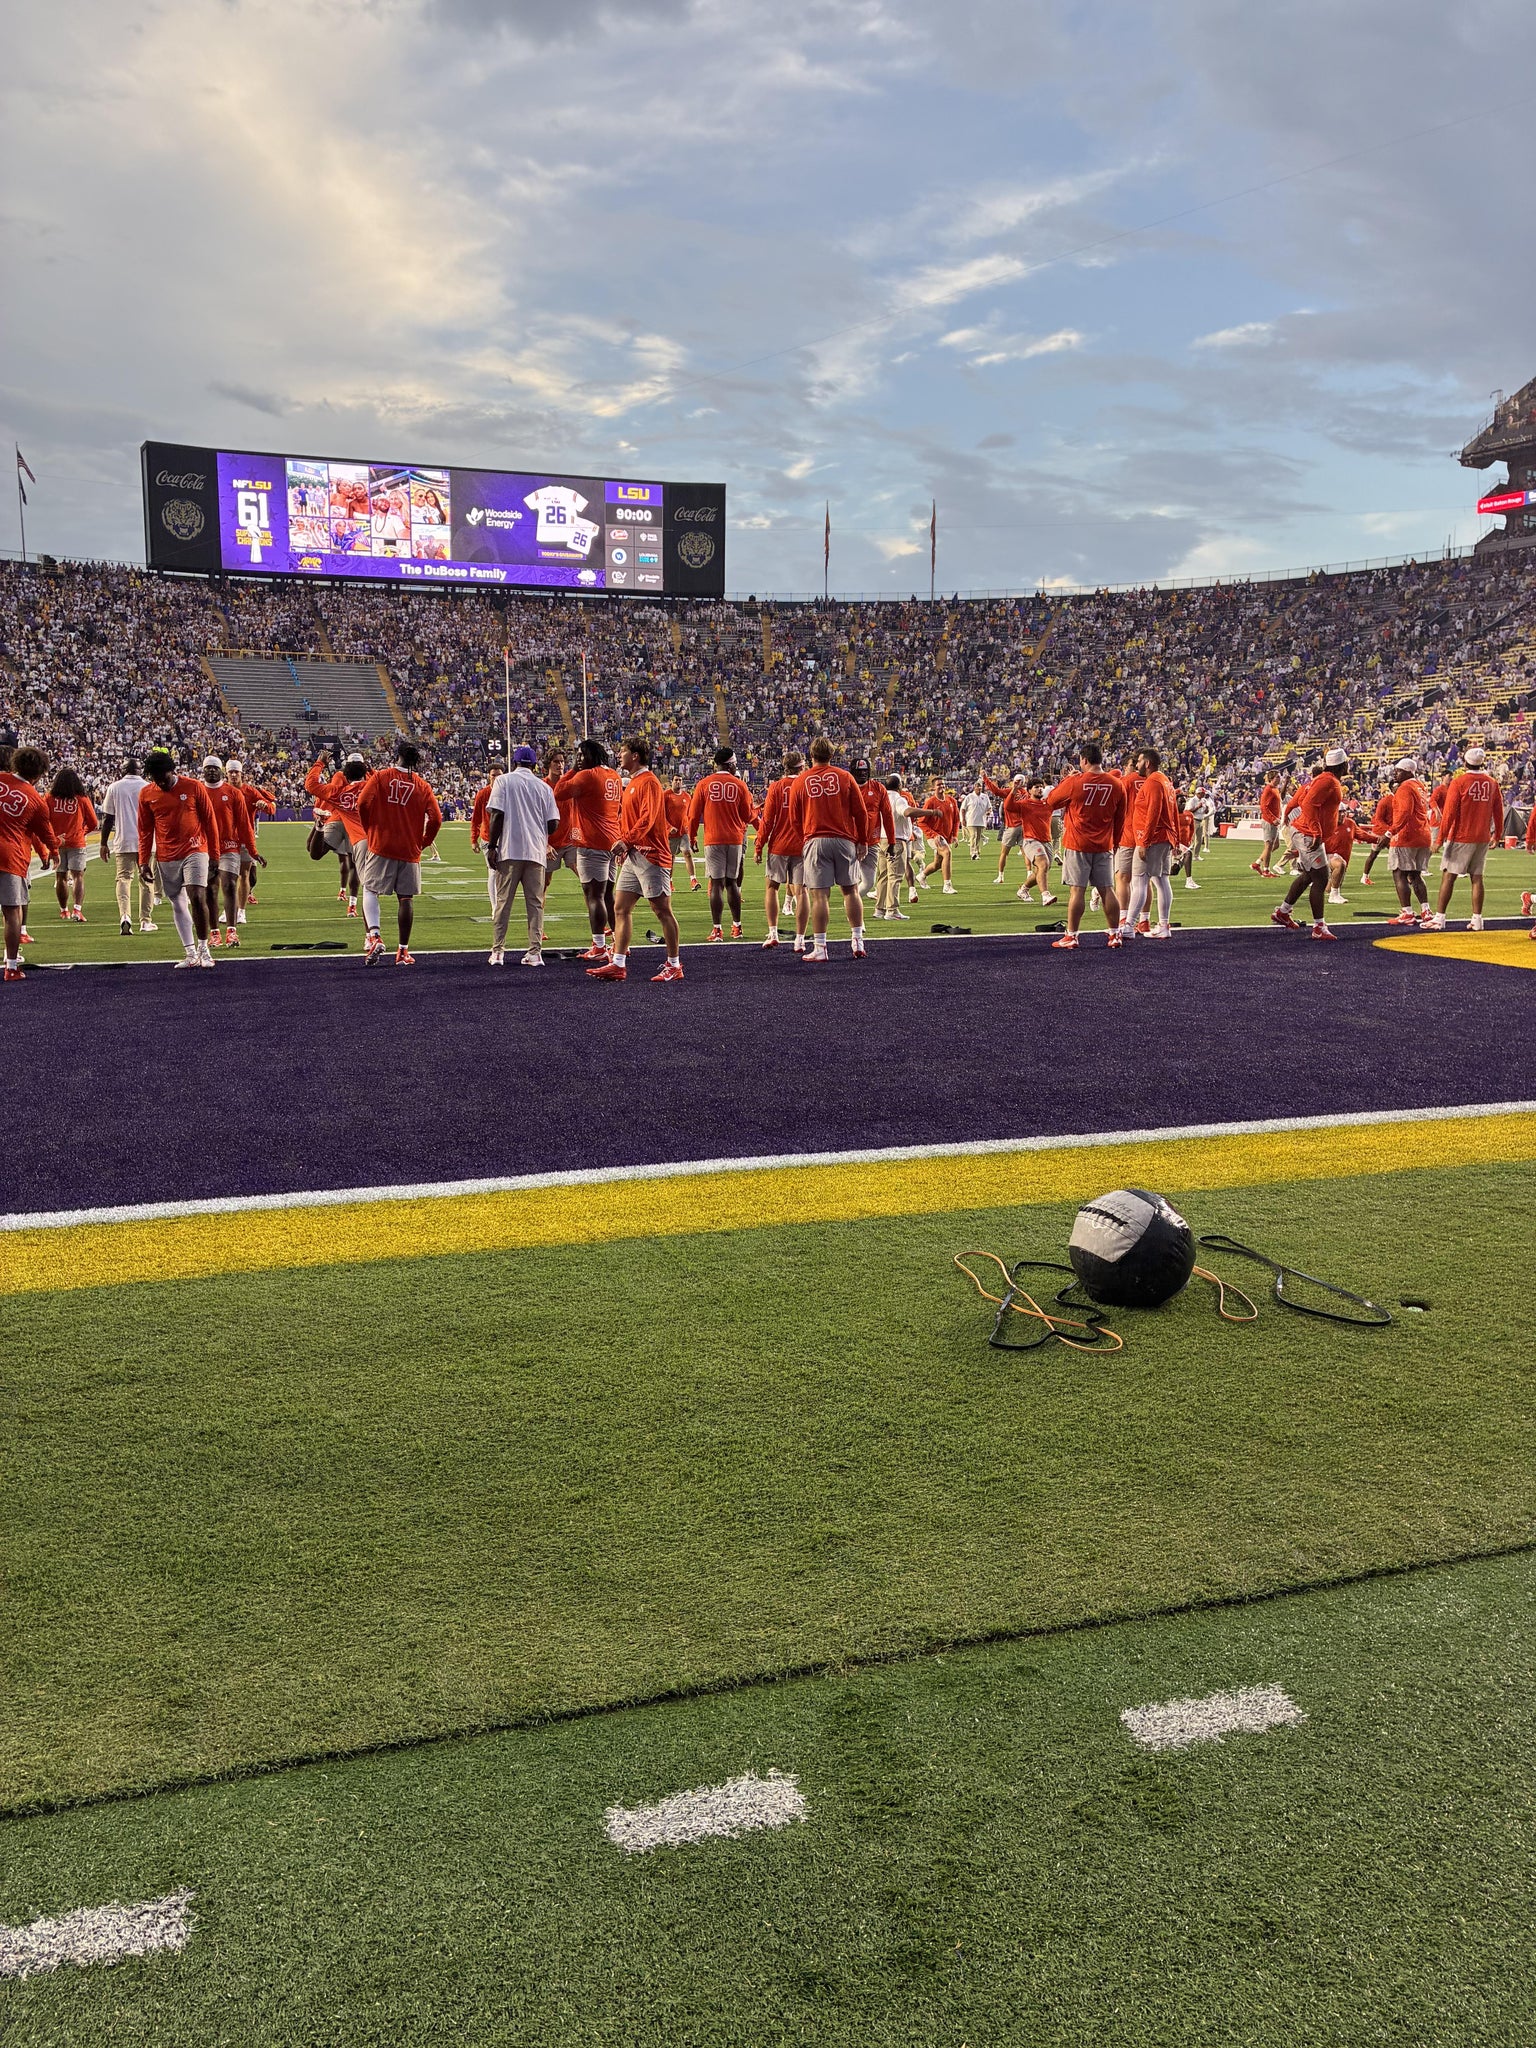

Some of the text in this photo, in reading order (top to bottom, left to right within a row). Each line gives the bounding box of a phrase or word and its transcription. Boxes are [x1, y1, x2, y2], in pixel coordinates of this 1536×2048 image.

[155, 469, 207, 490] Coca-Cola
[232, 479, 272, 490] NFLSU
[617, 486, 650, 501] LSU
[237, 491, 270, 529] 61
[485, 508, 523, 520] Woodside
[545, 505, 567, 524] 26
[616, 508, 652, 521] 90:00
[674, 506, 719, 522] Coca-Cola
[486, 517, 515, 529] Energy
[572, 531, 588, 548] 26
[399, 563, 508, 580] The DuBose Family
[488, 740, 502, 750] 25
[387, 778, 415, 806] 17
[604, 778, 621, 801] 91
[709, 781, 739, 802] 90
[805, 772, 840, 798] 63
[1469, 781, 1490, 801] 41
[1083, 783, 1113, 806] 77
[54, 796, 78, 814] 18
